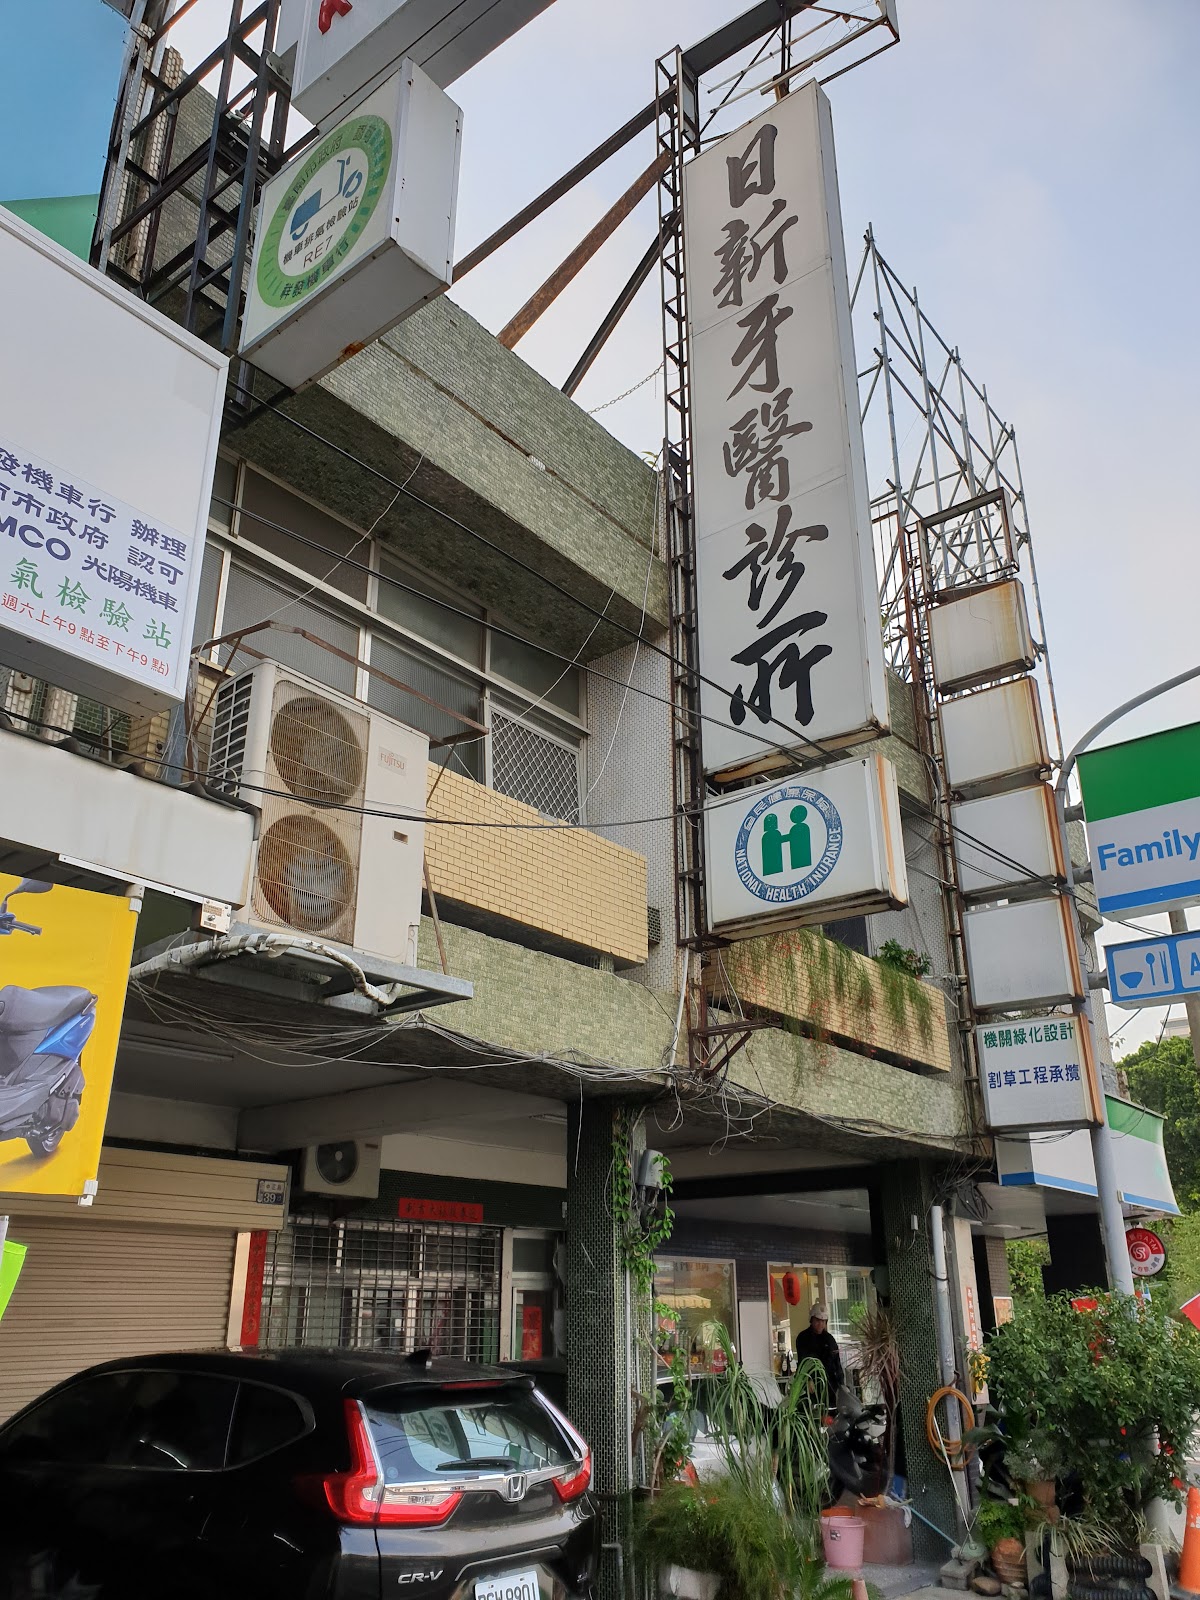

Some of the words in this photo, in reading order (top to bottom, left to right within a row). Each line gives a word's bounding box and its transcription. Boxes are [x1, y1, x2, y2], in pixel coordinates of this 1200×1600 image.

[283, 196, 359, 265] 機車排氣檢驗站
[303, 235, 333, 268] RE7
[713, 124, 832, 726] 日新牙醫診所
[131, 518, 187, 562] 辦理
[82, 555, 179, 614] 光陽機車
[127, 545, 183, 586] 認可
[9, 557, 172, 650] 氣檢驗站
[736, 848, 762, 896] NATIONAL
[766, 882, 808, 902] HEALTH
[983, 1022, 1074, 1049] 機關綠化設計
[988, 1064, 1080, 1089] 割草工程承攬
[397, 1569, 444, 1584] CR-V
